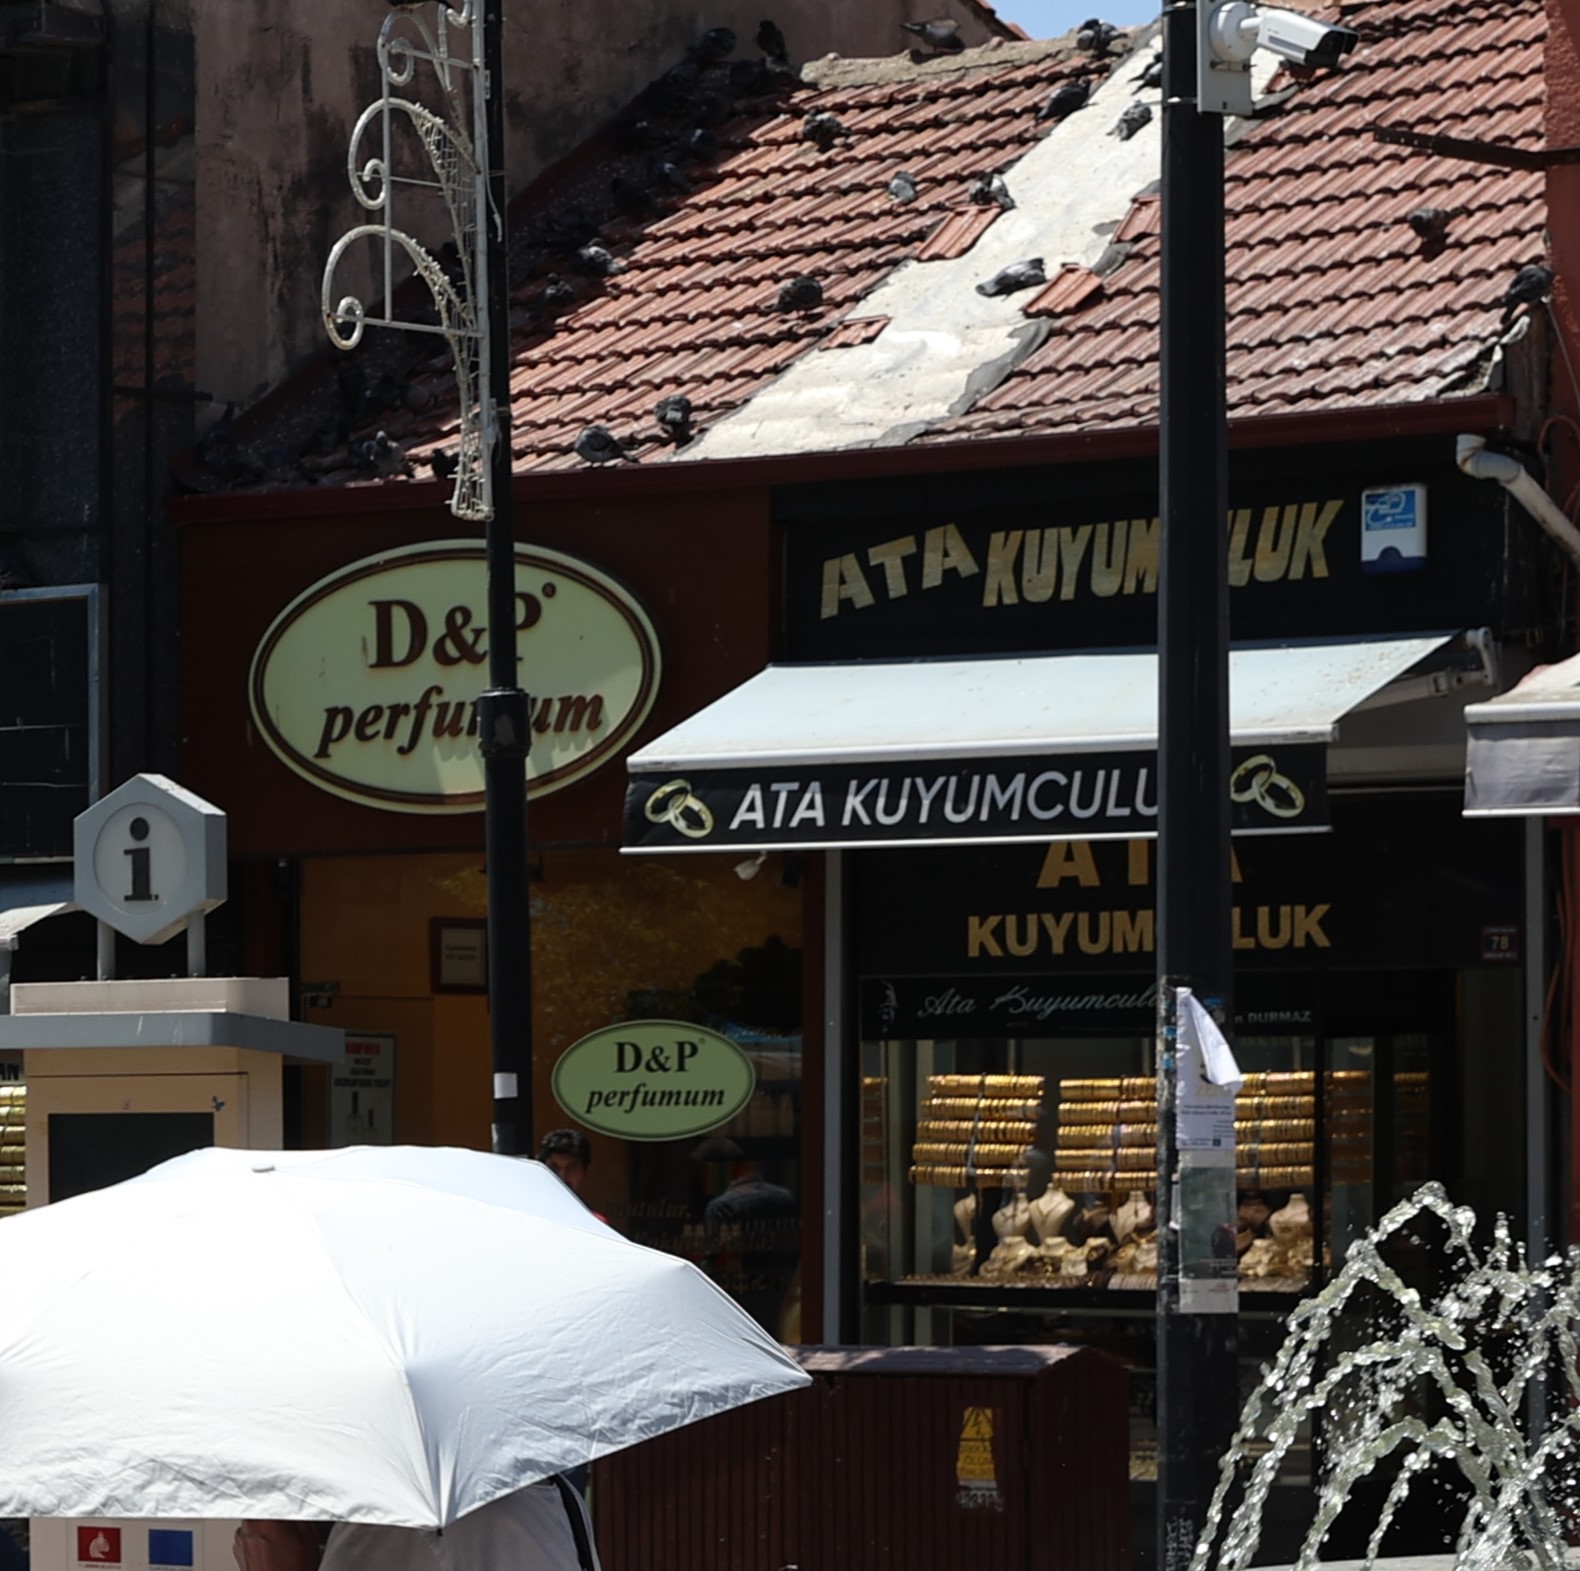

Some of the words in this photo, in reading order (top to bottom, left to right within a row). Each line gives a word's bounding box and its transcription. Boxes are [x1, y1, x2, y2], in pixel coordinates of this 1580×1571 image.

[820, 521, 980, 620] ATA
[982, 499, 1344, 608] KUYUMLUK
[729, 780, 826, 831] ATA
[841, 767, 1159, 827] KUYUMCULU
[967, 903, 1332, 957] KUYUMLUK
[614, 1040, 699, 1073] D&P
[585, 1082, 725, 1115] perfumum
